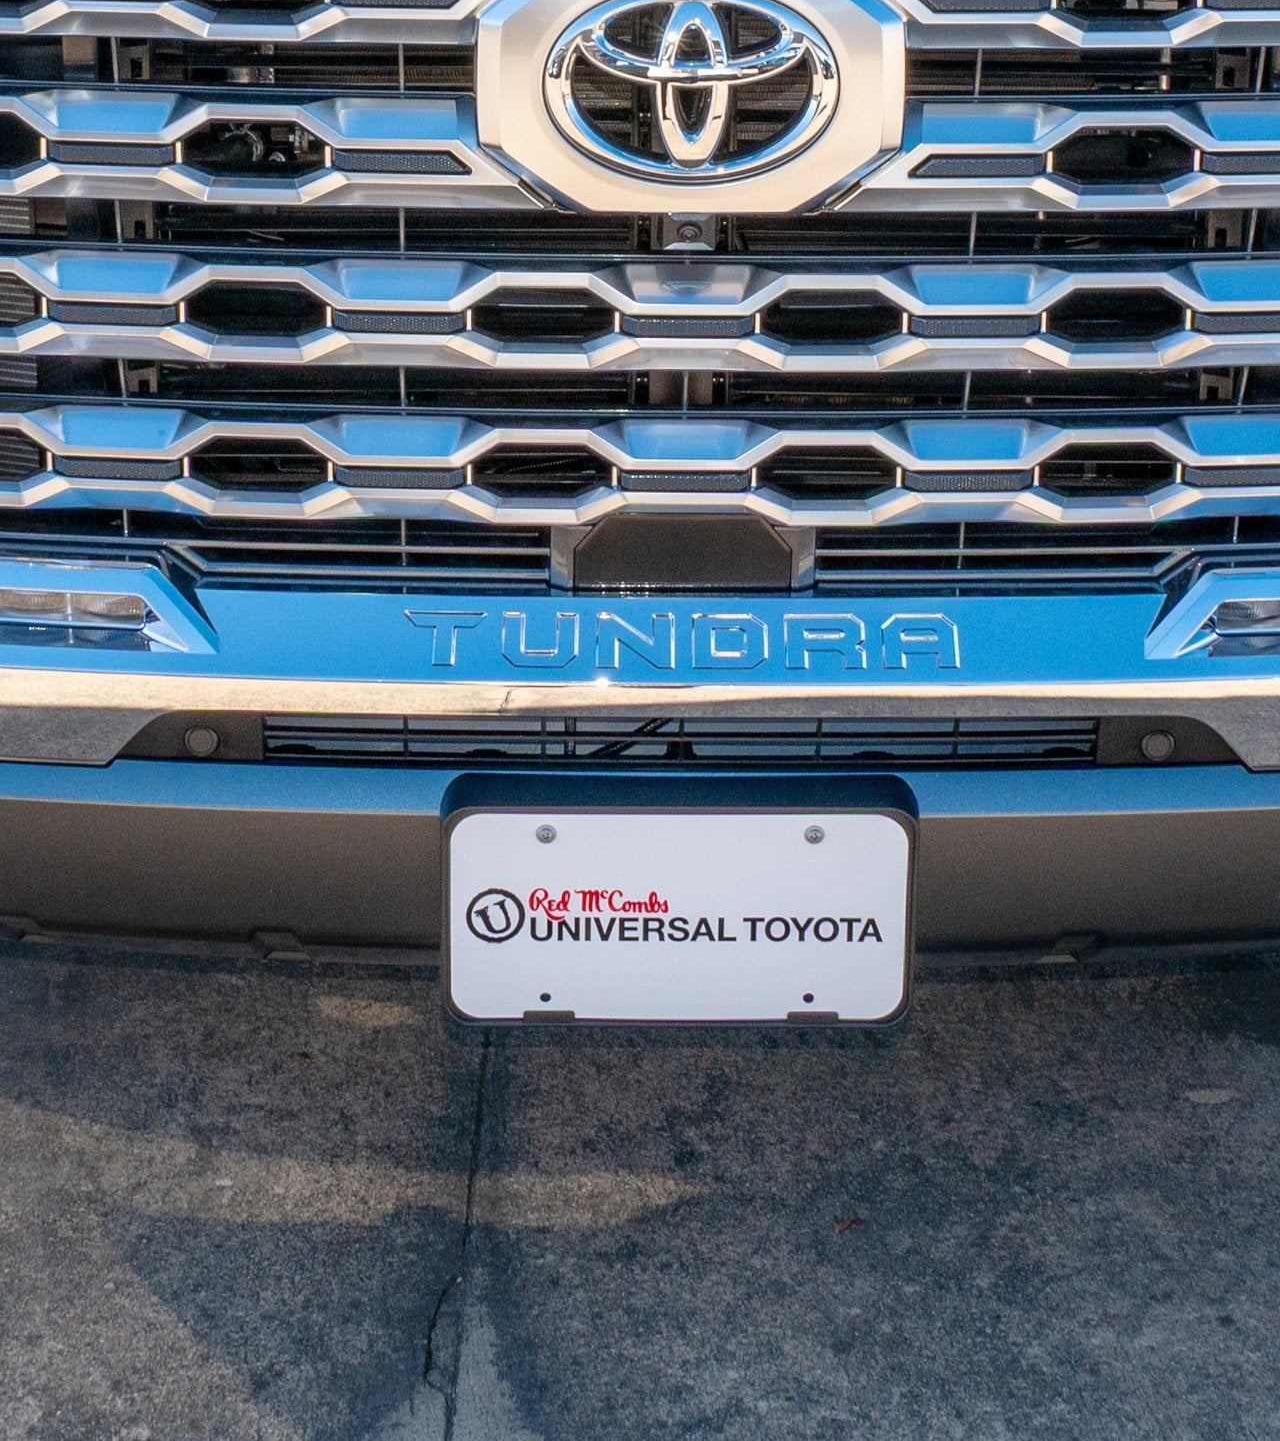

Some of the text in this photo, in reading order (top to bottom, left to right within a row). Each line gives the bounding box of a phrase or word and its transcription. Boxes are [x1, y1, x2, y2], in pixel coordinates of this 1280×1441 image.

[403, 609, 962, 670] TUNDRA
[528, 887, 669, 921] Red McCombs
[530, 916, 883, 943] UNIVERSAL TOYOTA
